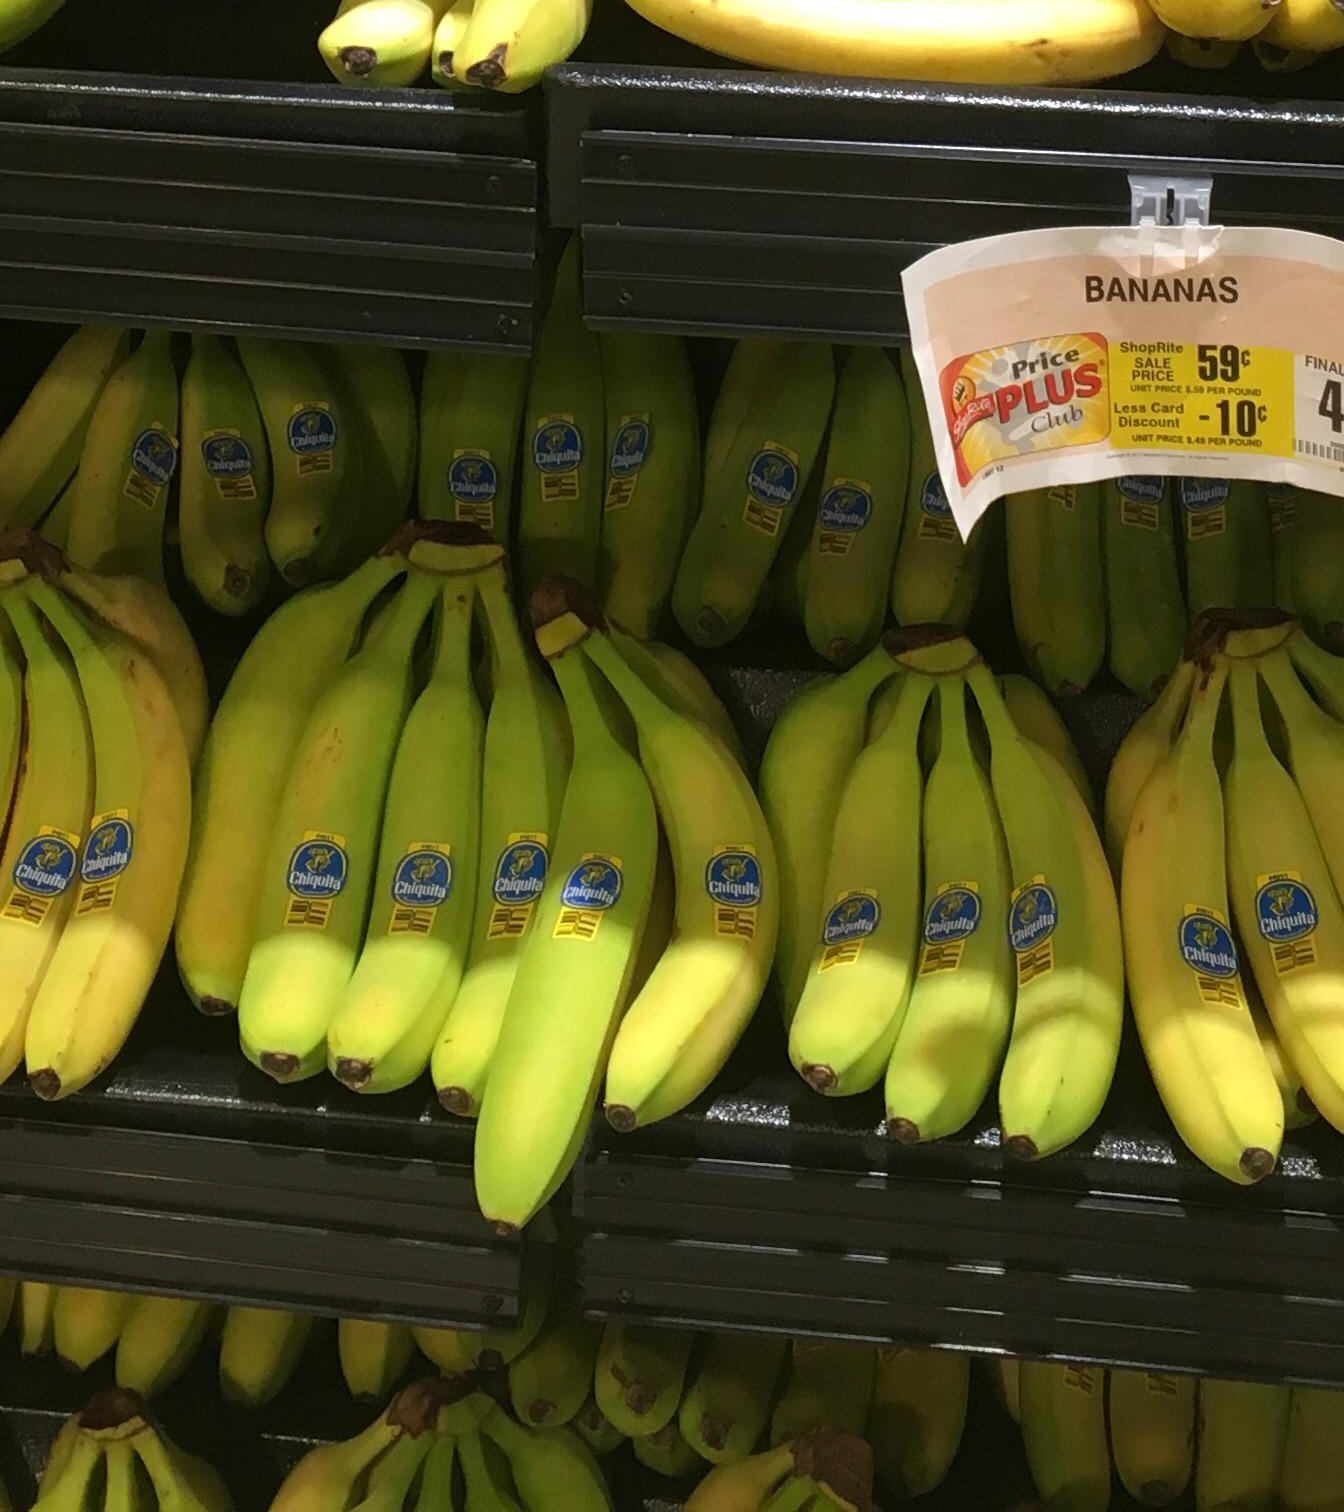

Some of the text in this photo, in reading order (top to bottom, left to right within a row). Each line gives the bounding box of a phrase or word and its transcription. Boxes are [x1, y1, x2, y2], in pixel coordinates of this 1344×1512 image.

[1085, 275, 1238, 303] BANANAS
[1120, 341, 1184, 354] ShopRite
[1012, 348, 1080, 379] Price
[1134, 357, 1171, 369] SALE
[1131, 370, 1174, 382] PRICE
[995, 363, 1103, 424] PLUS
[1130, 384, 1152, 393] UNIT
[1156, 385, 1182, 394] PRICE
[1207, 387, 1226, 395] PER
[1228, 388, 1262, 397] POUND
[1114, 402, 1184, 414] Less Card
[1031, 405, 1083, 433] Club
[1118, 416, 1180, 428] Discount
[291, 434, 335, 446] Chiquita
[1132, 434, 1153, 442] UNIT
[1156, 434, 1184, 443] PRICE
[1208, 437, 1227, 446] PER
[1229, 438, 1262, 448] POUND
[536, 451, 580, 464] Chiquita
[451, 482, 495, 495] Chiquita
[748, 474, 791, 500] Chiquita
[821, 509, 865, 526] Chiquita
[82, 851, 127, 873] Chiquita
[16, 864, 66, 889] Chiquita
[289, 872, 341, 890] Chiquita
[394, 881, 446, 899] Chiquita
[495, 879, 543, 893] Chiquita
[709, 881, 760, 897] Chiquita
[562, 887, 613, 905] Chiquita
[826, 920, 873, 937] Chiquita
[926, 919, 975, 936] Chiquita
[1012, 914, 1054, 945] Chiquita
[1260, 914, 1315, 934] Chiquita
[1184, 945, 1236, 969] Chiquita
